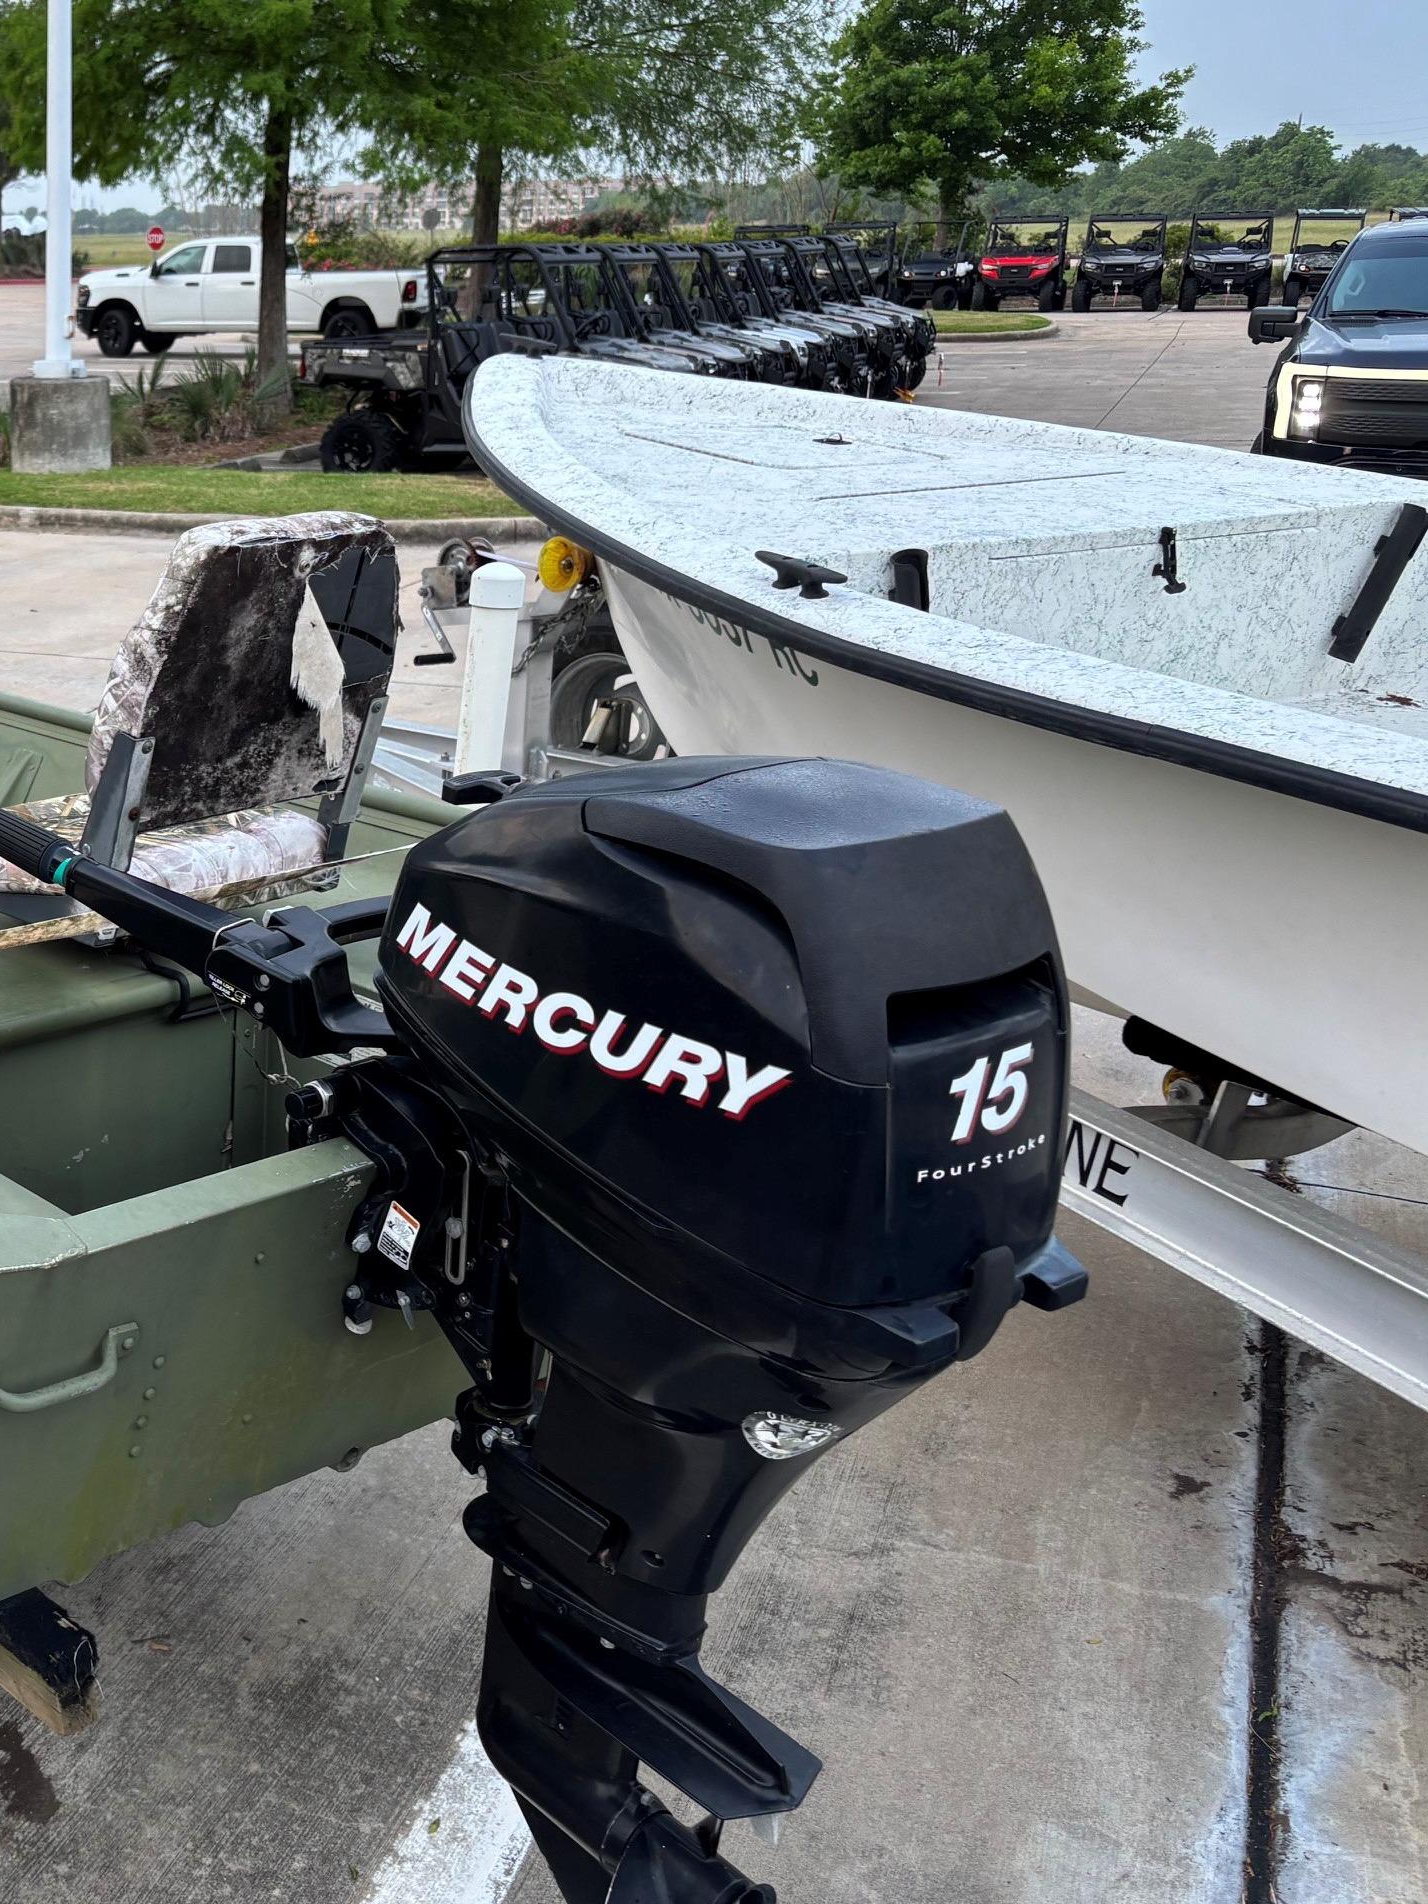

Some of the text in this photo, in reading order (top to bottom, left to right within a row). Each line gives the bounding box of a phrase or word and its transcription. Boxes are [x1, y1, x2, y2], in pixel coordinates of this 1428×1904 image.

[147, 233, 164, 244] STOP
[395, 902, 794, 1121] MERCURY
[949, 1042, 1034, 1145] 15
[917, 1134, 1045, 1183] FourStroke
